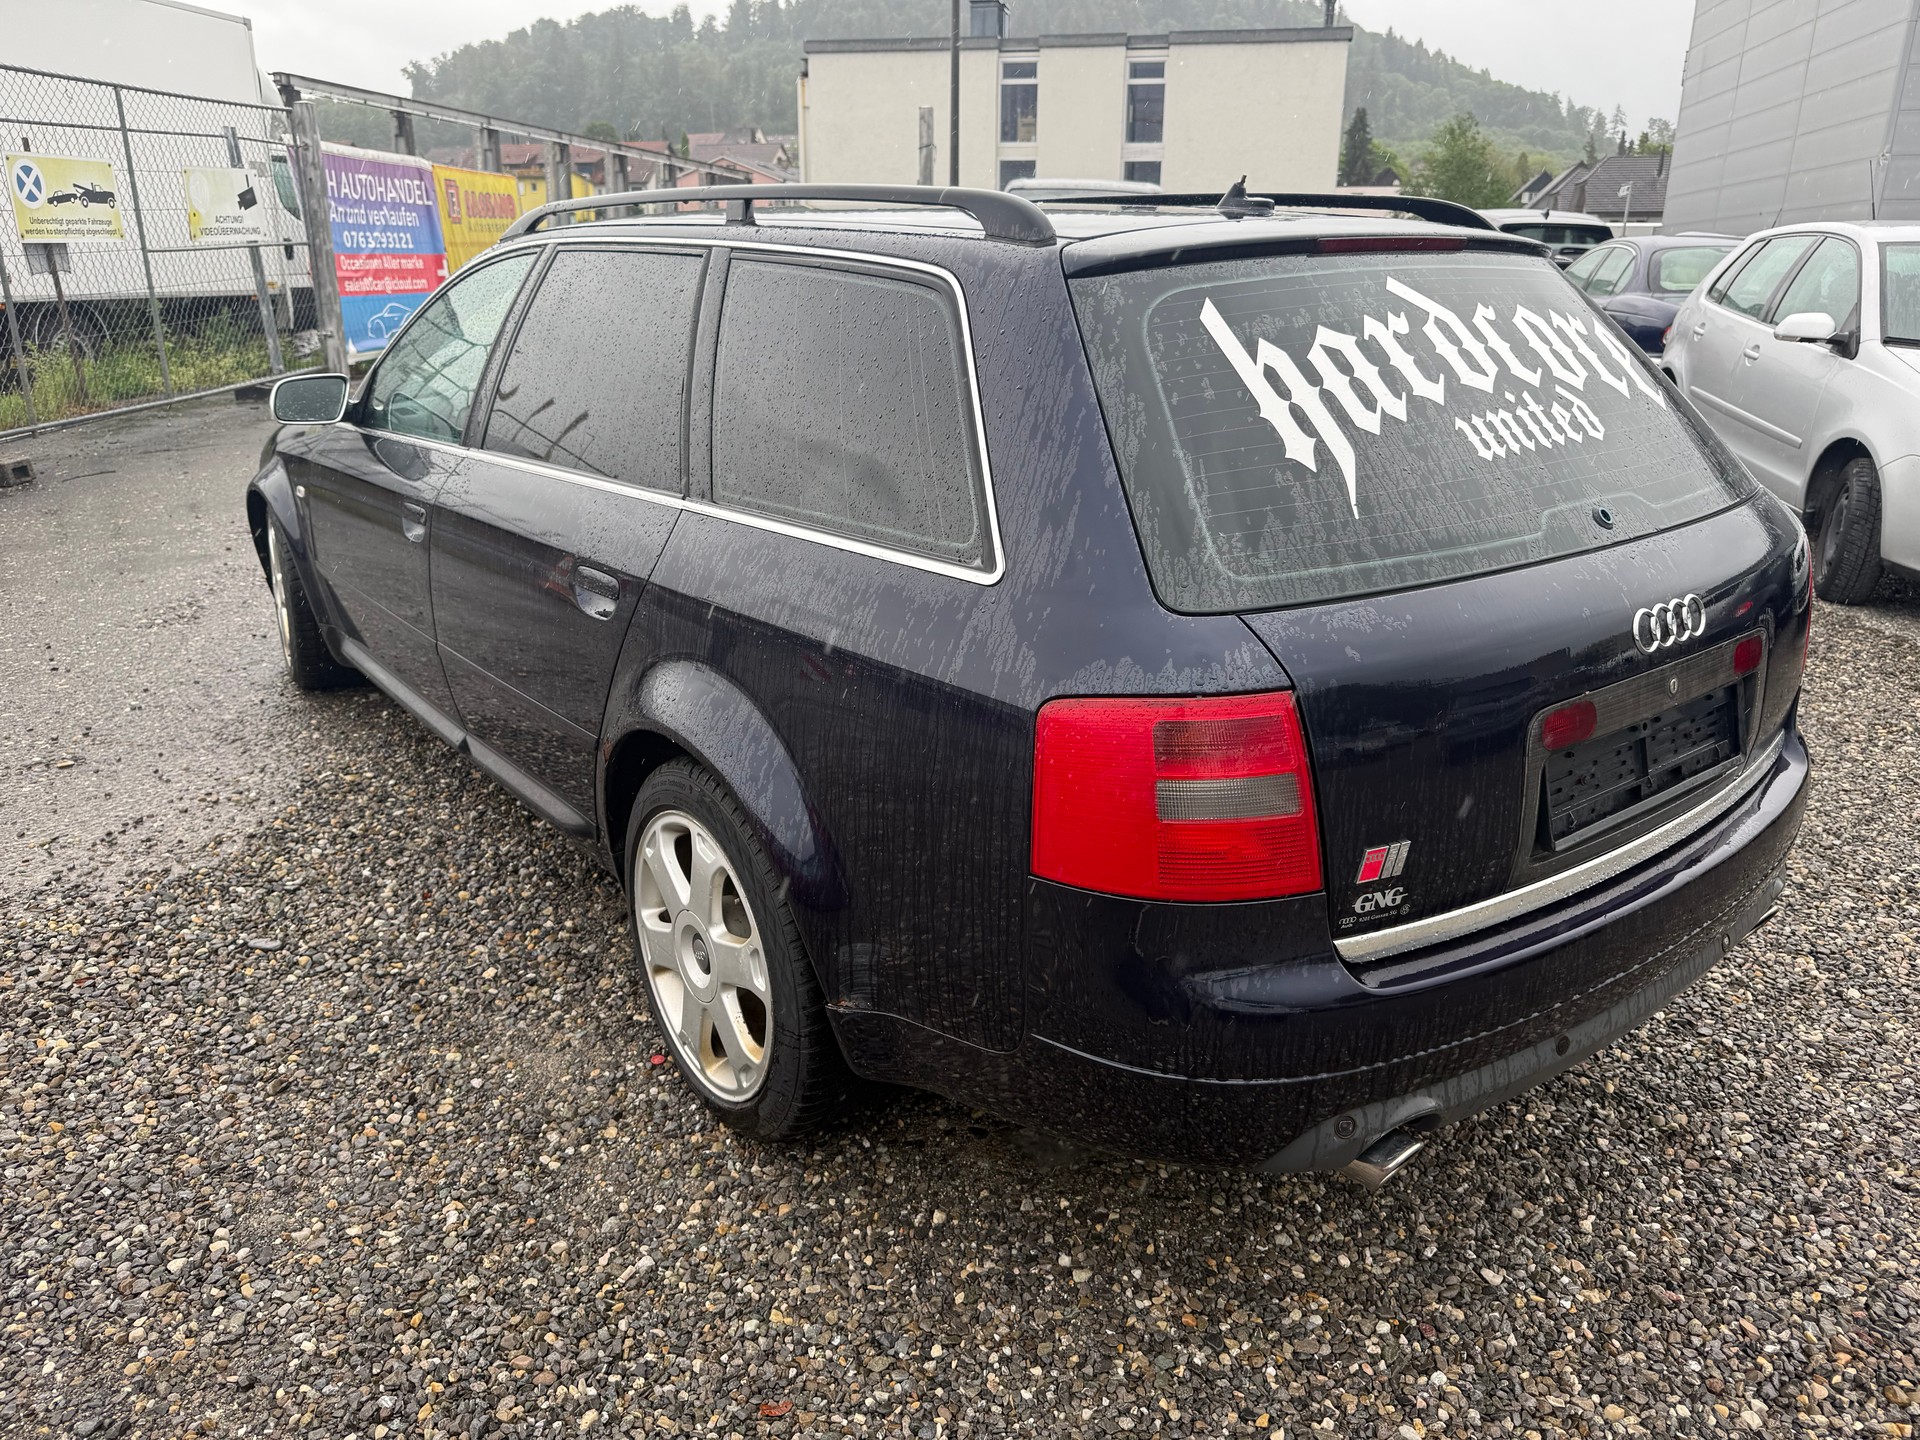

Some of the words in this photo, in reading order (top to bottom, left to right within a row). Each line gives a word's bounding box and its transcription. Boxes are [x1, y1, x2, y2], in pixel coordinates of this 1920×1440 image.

[340, 171, 433, 206] AUTOHANDEL
[29, 216, 64, 226] Unberechtigt
[65, 218, 87, 226] geparkte
[87, 217, 112, 227] Fahrzeuge
[215, 215, 244, 224] ACHTUNG!
[329, 200, 346, 223] An
[346, 203, 367, 225] und
[199, 225, 261, 236] VIDEOÜBERWACHUNG
[1454, 384, 1605, 461] united
[1352, 886, 1409, 913] GNG
